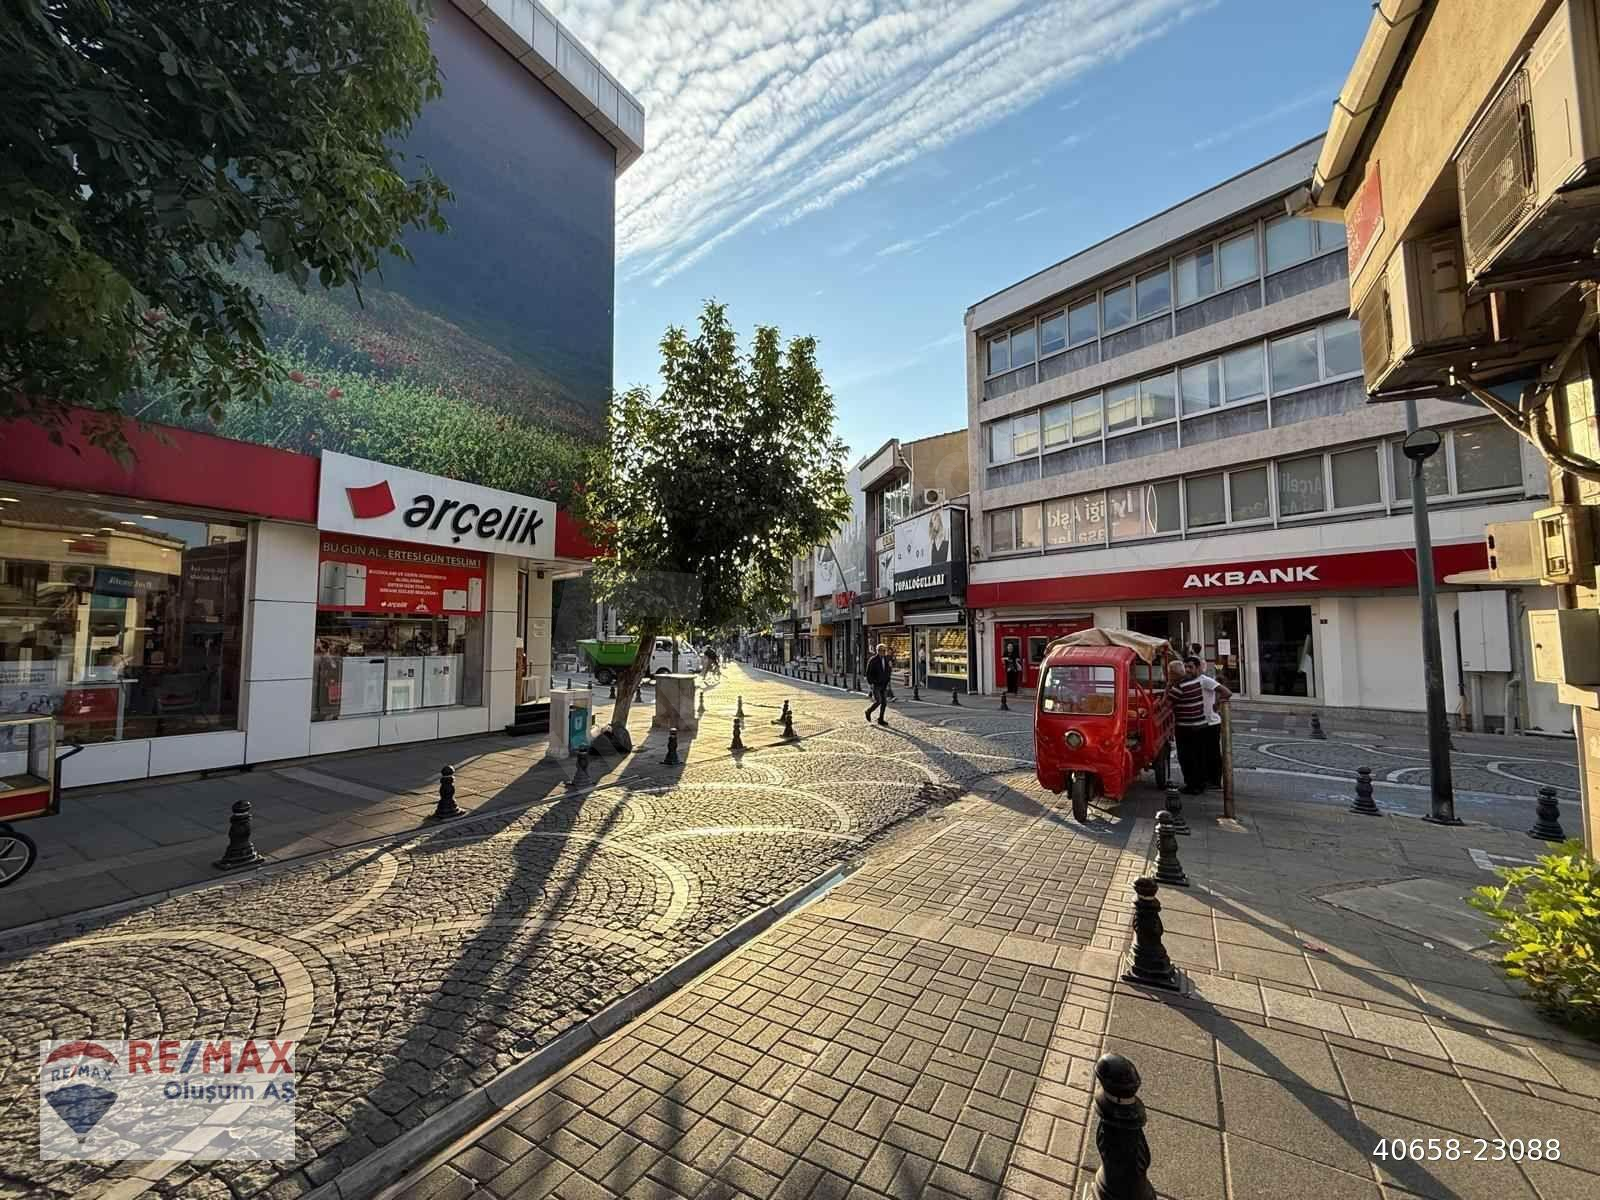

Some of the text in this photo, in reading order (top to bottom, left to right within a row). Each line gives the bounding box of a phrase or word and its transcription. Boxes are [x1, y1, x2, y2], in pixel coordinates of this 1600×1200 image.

[402, 494, 544, 545] arçelik
[323, 542, 339, 553] BU
[341, 543, 366, 555] GÜN
[423, 553, 445, 565] GÜN
[895, 573, 945, 592] TOPALOĞULLARI
[1183, 565, 1320, 588] AKBANK
